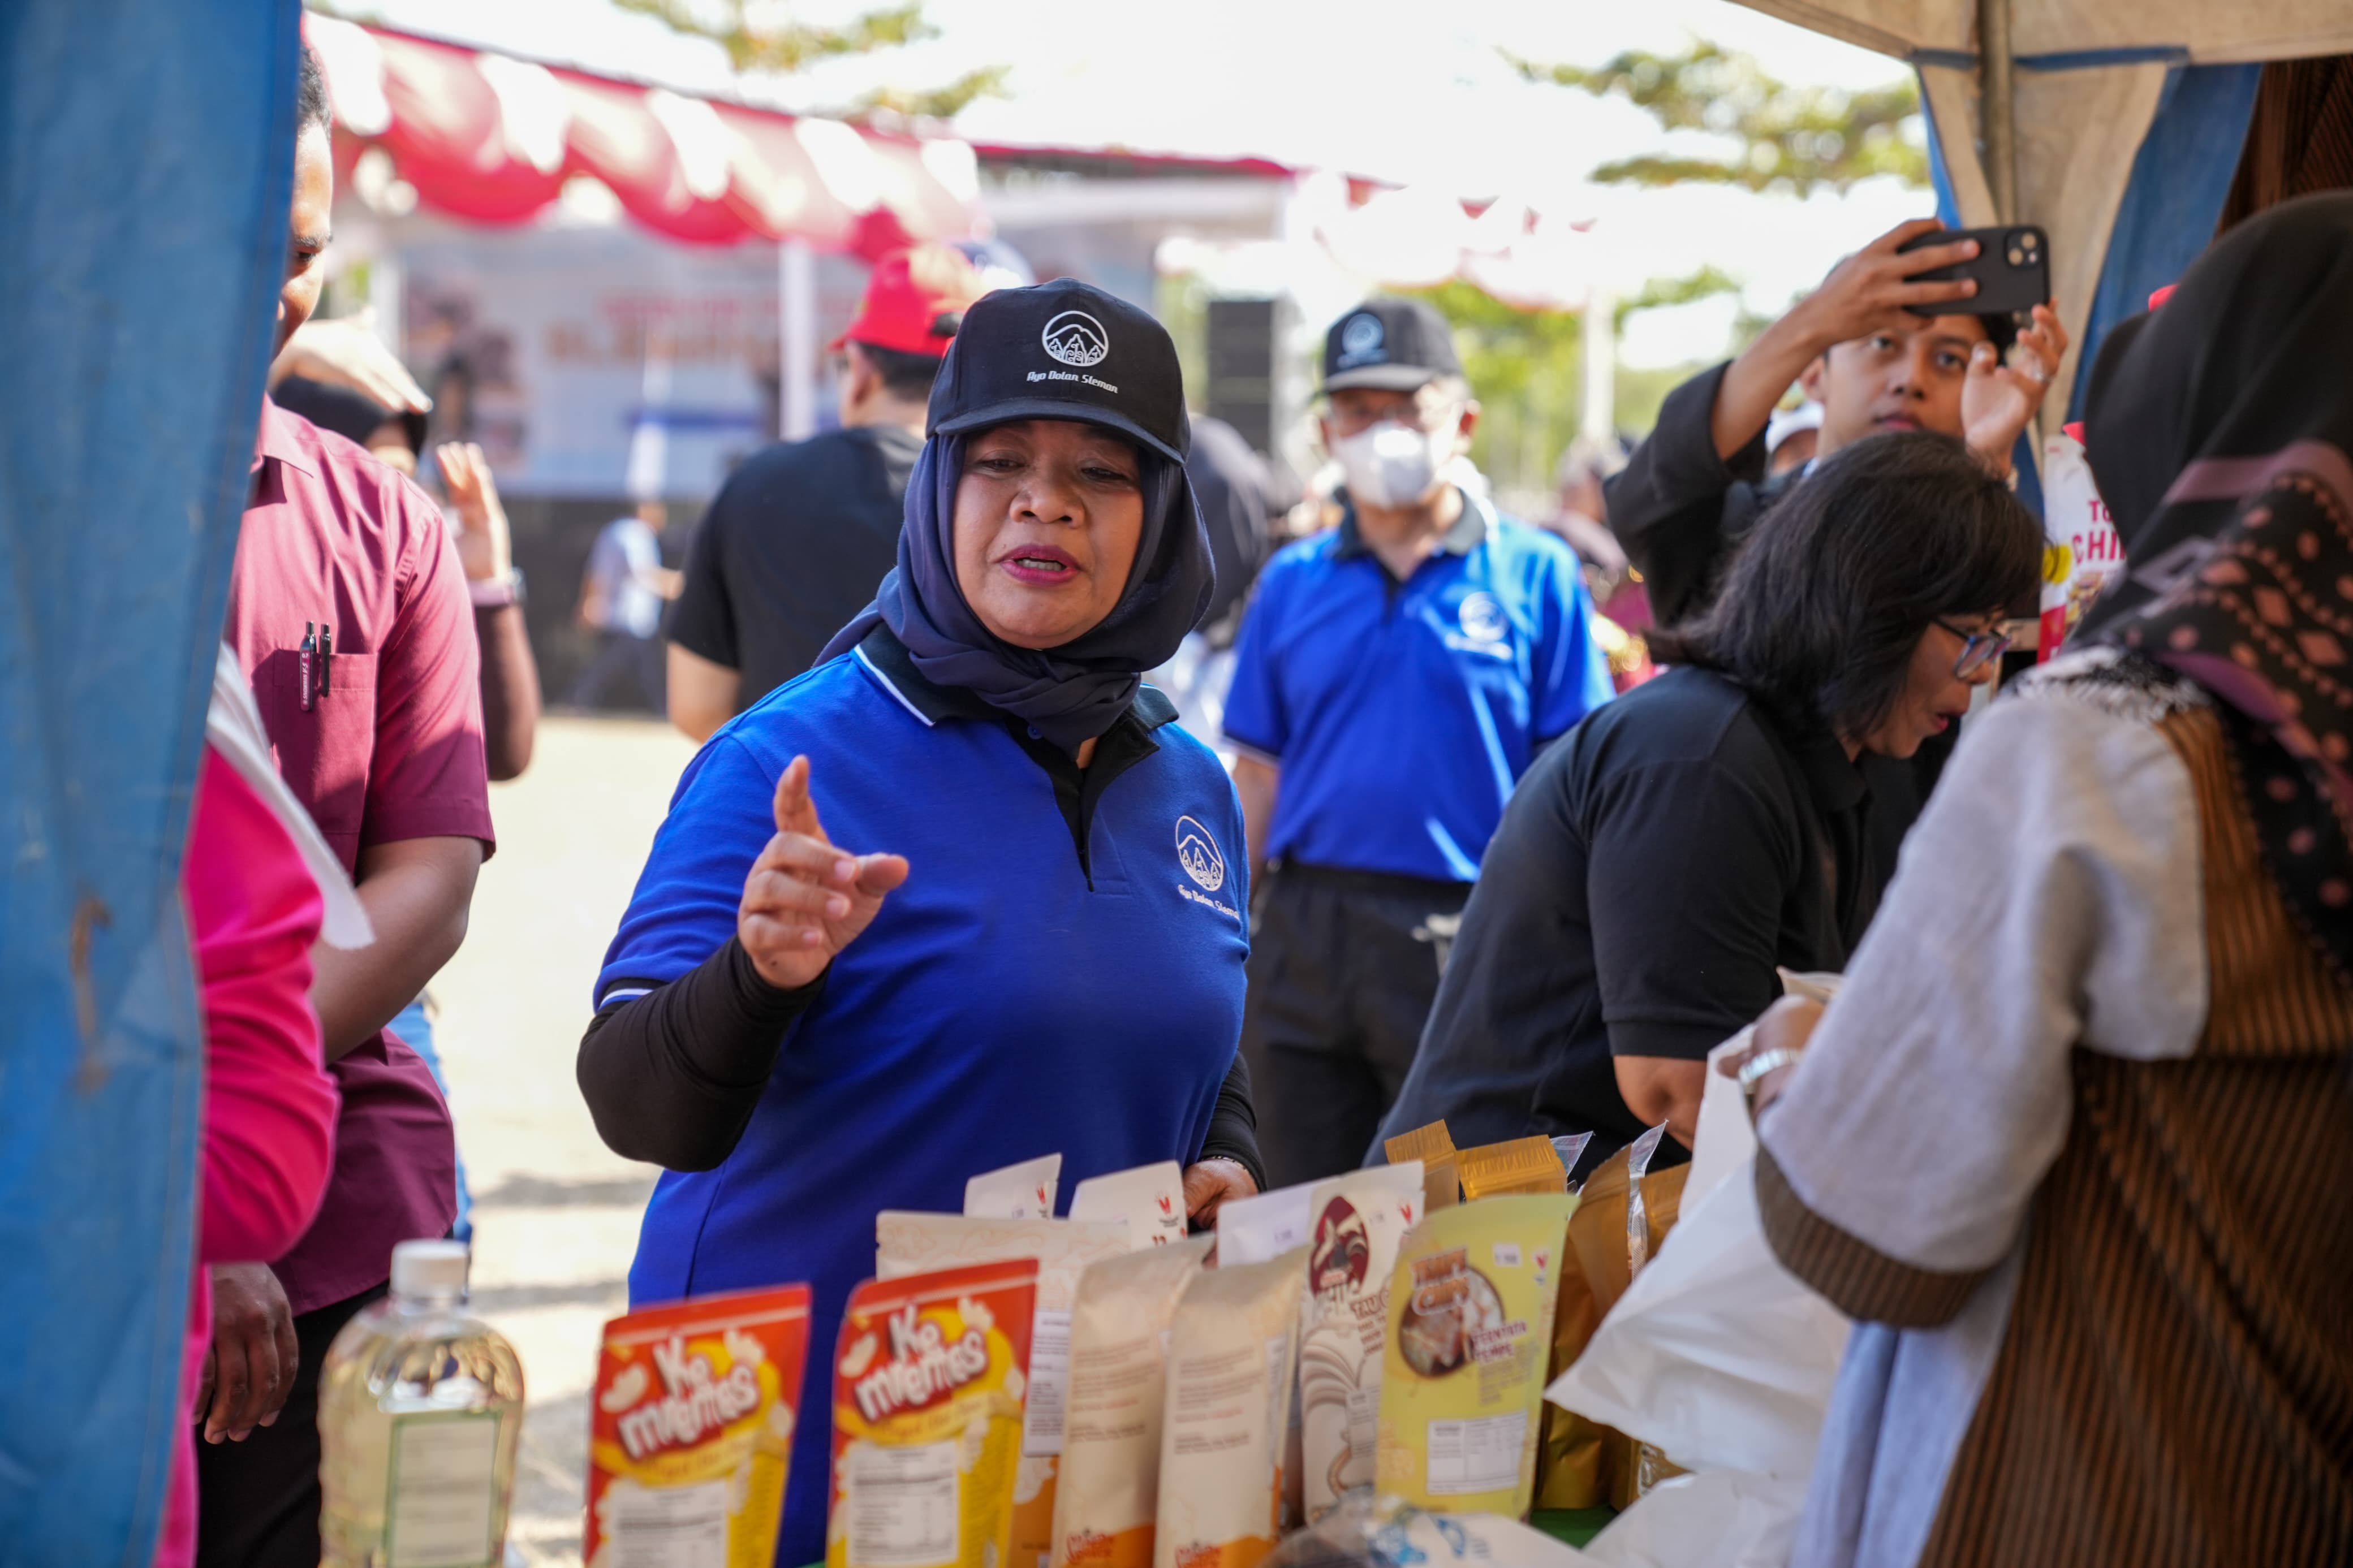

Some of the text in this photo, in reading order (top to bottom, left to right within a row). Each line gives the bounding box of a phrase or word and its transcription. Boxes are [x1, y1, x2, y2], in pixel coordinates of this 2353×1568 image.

[1027, 370, 1118, 394] Ayo Dolan Sleman
